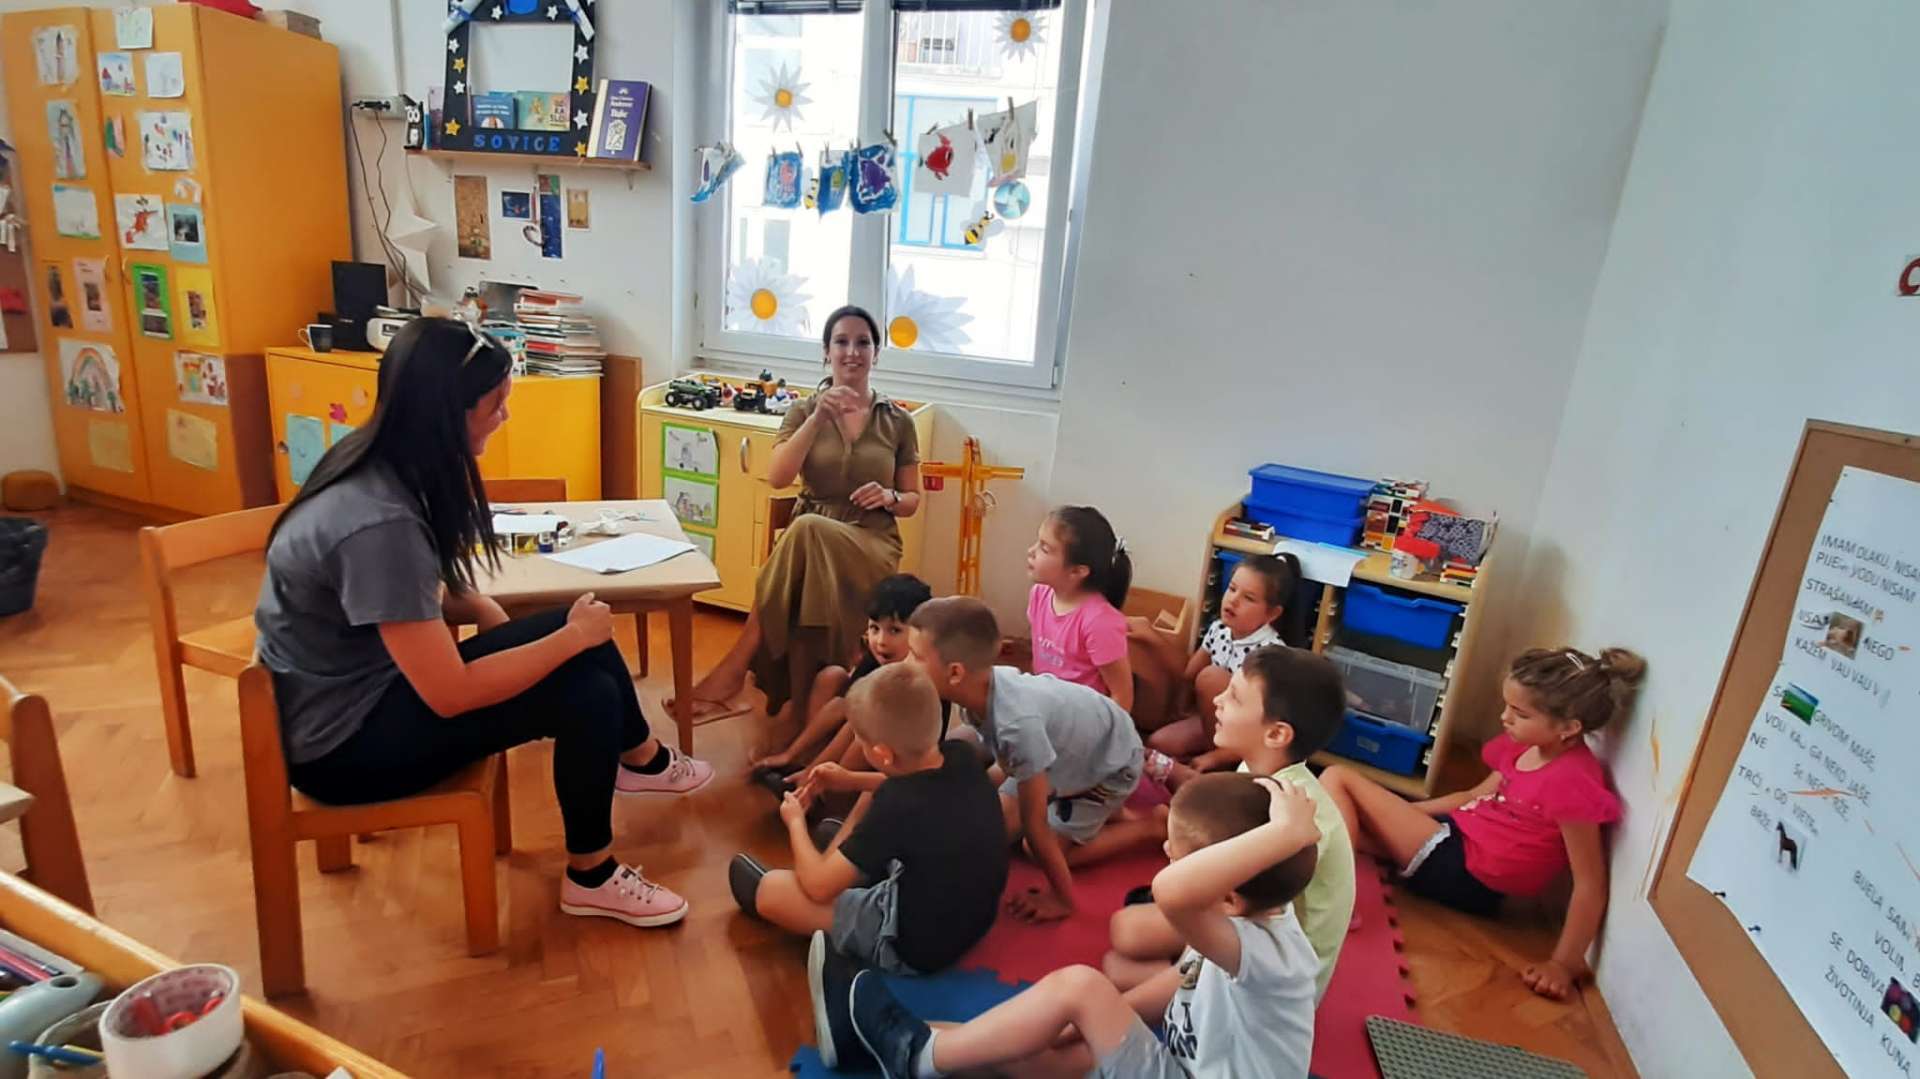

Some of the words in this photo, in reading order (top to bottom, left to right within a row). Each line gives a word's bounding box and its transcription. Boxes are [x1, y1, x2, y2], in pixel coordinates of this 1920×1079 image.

[1821, 534, 1856, 553] IMAM
[1881, 577, 1916, 603] NISAM
[1862, 637, 1895, 661] NEGO
[1830, 657, 1850, 679] VAU
[1850, 669, 1873, 692] VAU
[1750, 732, 1769, 750] NE
[1853, 869, 1885, 911] BIJELA
[1829, 931, 1844, 951] SE
[1824, 964, 1876, 1029] ŽIVOTINJA
